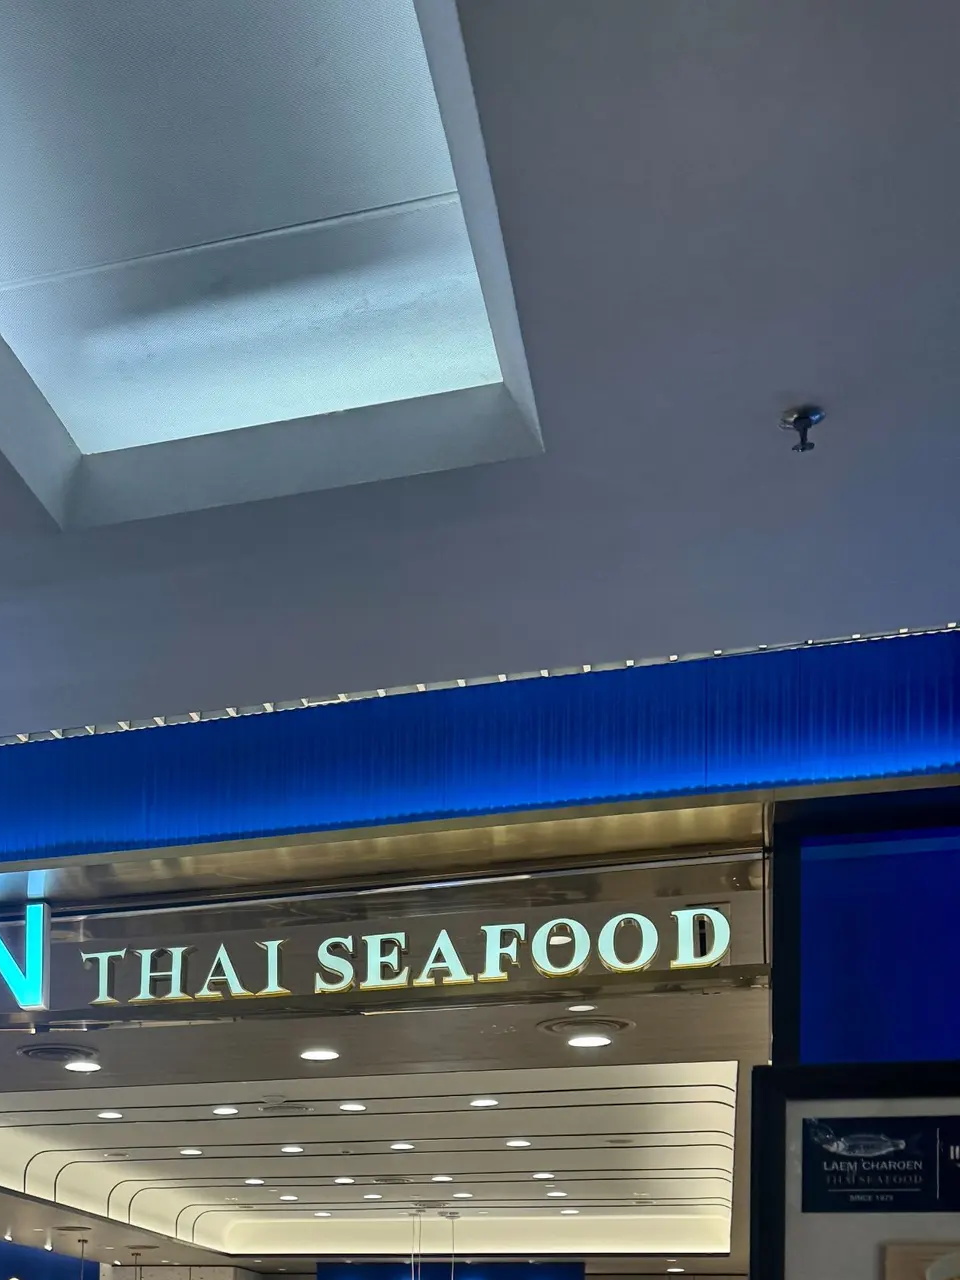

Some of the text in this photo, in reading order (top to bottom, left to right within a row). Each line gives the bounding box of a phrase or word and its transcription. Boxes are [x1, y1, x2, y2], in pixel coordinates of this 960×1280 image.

[81, 906, 732, 1005] THAI SEAFOOD
[823, 1159, 923, 1172] LAEM CHAROEN
